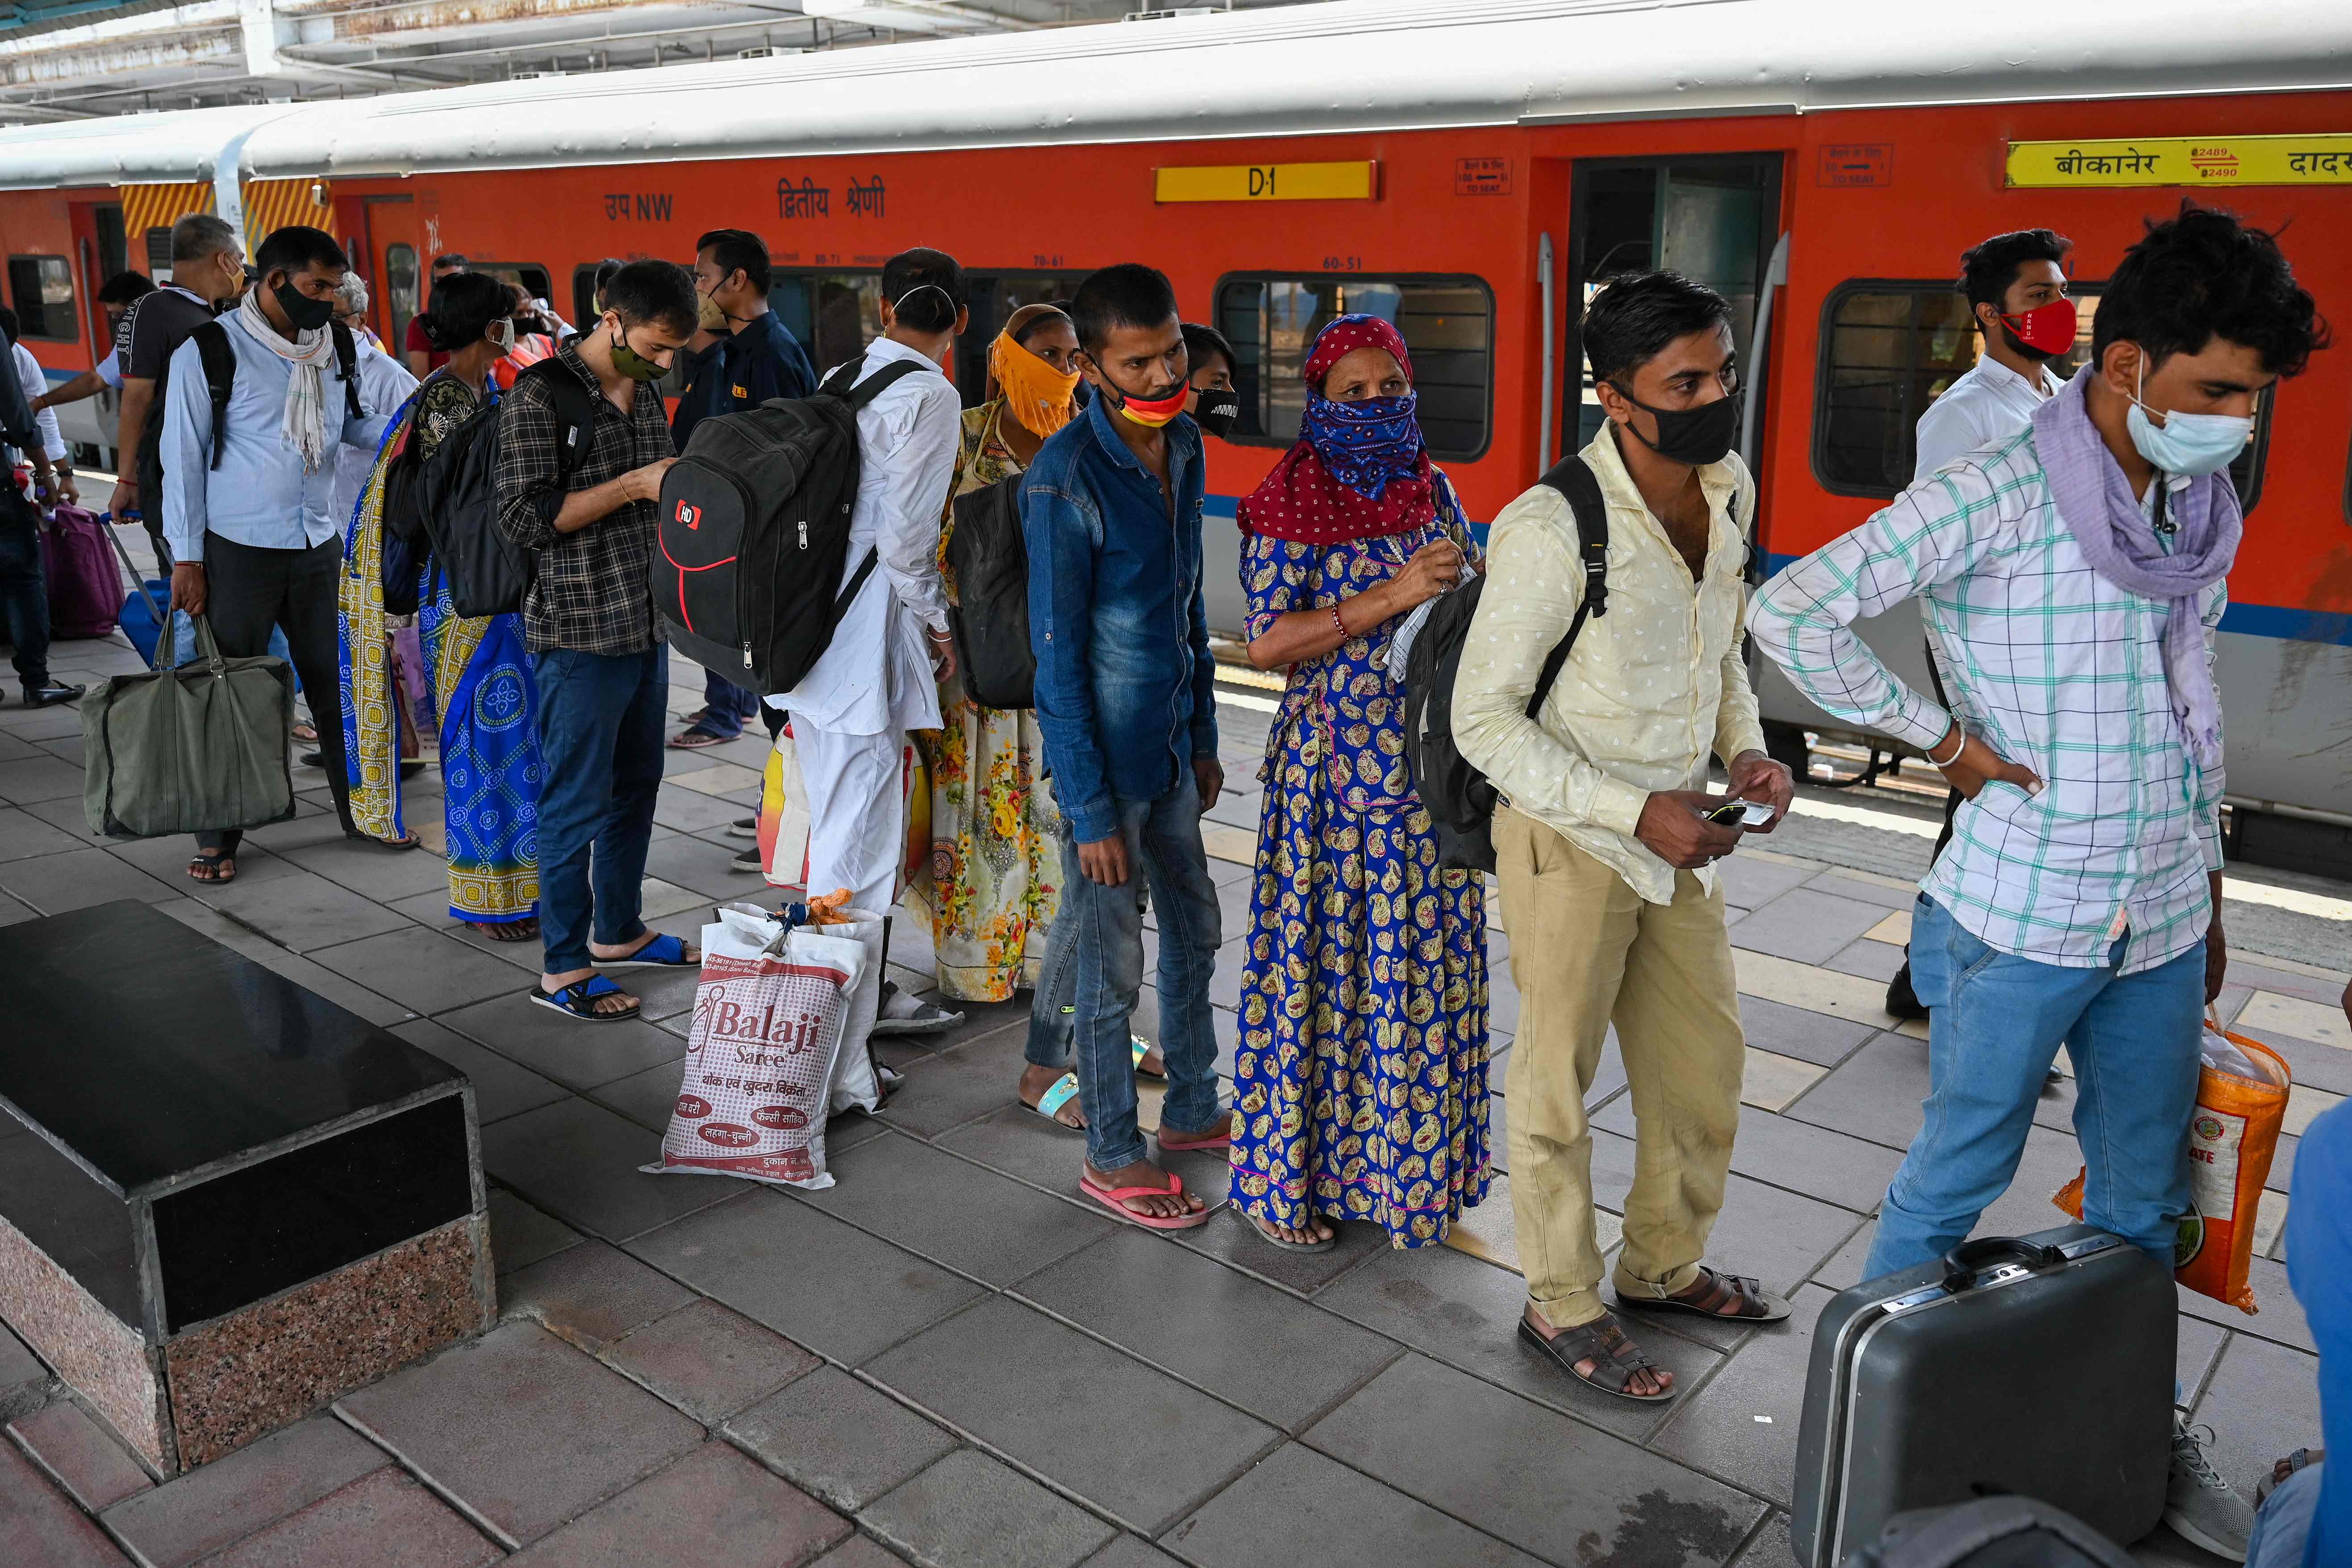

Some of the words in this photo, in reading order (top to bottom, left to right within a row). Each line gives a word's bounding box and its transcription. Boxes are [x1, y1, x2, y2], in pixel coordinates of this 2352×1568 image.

[2055, 147, 2160, 175] बीकानेर
[2191, 148, 2228, 156] 02489
[1833, 175, 1847, 183] TO
[1850, 174, 1875, 183] SEAT
[2201, 169, 2237, 177] 02490
[777, 177, 830, 219] द्वितीय
[847, 175, 885, 218] श्रेणी
[1480, 184, 1500, 193] SEAT
[604, 193, 630, 221] उप
[636, 193, 672, 221] NW
[1323, 257, 1362, 270] 60-51
[681, 505, 692, 523] HD
[713, 1001, 821, 1055] Balaji
[734, 1045, 784, 1068] Saree
[702, 1072, 724, 1086] थोक
[725, 1076, 742, 1089] एवं
[743, 1080, 774, 1097] खुदरा
[705, 1126, 752, 1144] लहंगा-चुन्नी
[763, 1158, 788, 1168] दुकान
